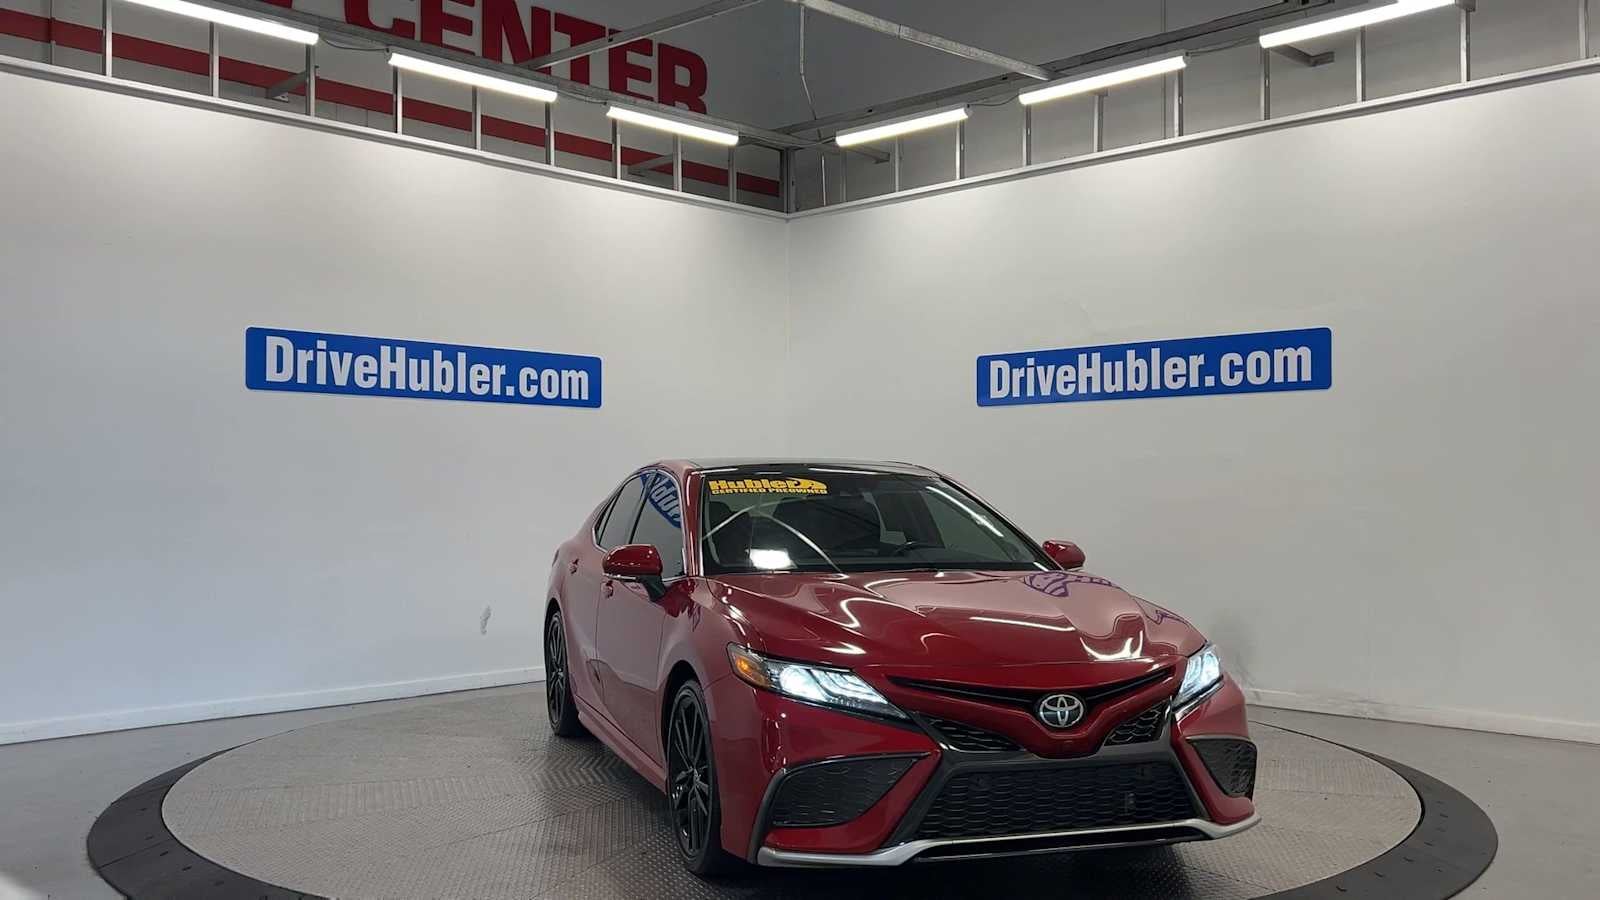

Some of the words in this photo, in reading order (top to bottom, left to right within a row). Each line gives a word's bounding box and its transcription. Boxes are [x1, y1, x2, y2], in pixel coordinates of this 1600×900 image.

[265, 335, 589, 400] DriveHubler.com
[989, 346, 1313, 399] DriveHubler.com
[708, 479, 801, 490] Hubler
